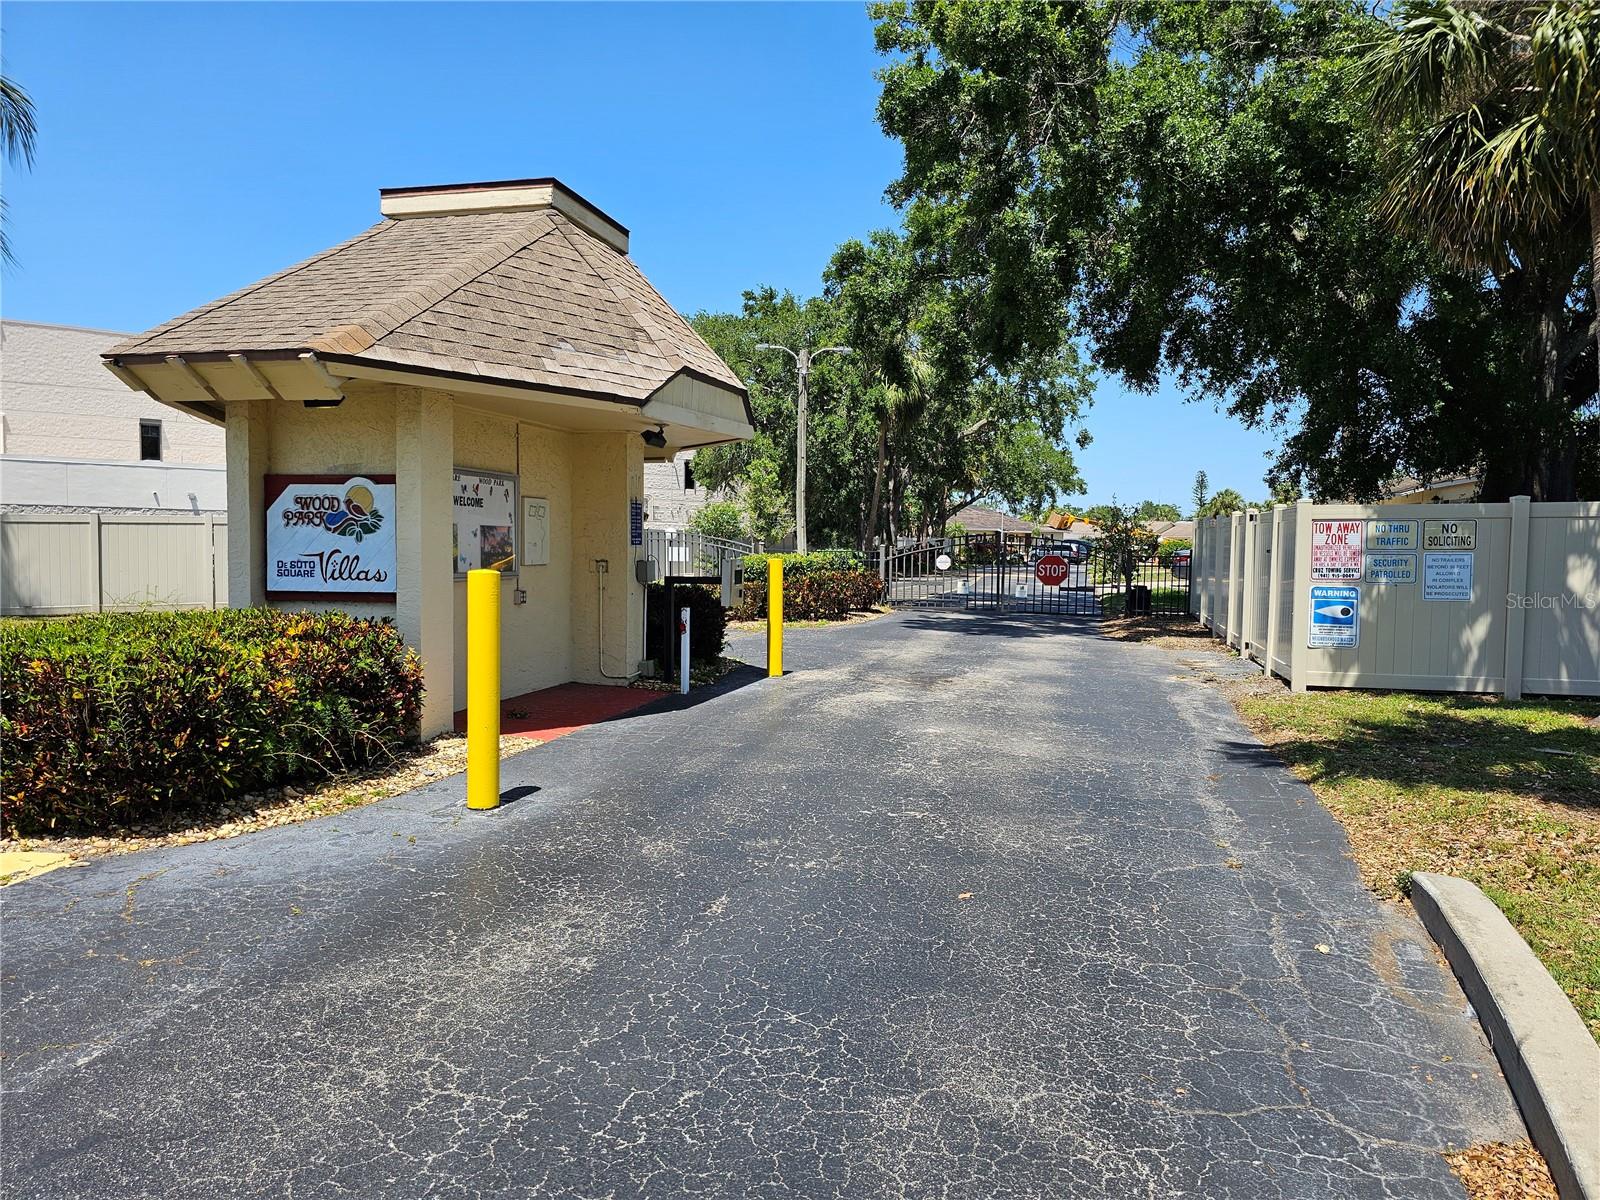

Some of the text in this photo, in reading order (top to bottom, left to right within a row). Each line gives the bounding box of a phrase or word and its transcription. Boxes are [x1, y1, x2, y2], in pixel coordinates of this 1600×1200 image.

[493, 479, 505, 487] PARK
[293, 494, 340, 512] WOOD
[453, 495, 484, 508] WELCOME
[283, 510, 328, 528] PARK
[1314, 523, 1360, 534] TOW AWAY
[1376, 525, 1410, 533] NO THRU
[1441, 524, 1458, 534] NO
[1325, 534, 1349, 545] ZONE
[1376, 537, 1409, 546] TRAFFIC
[1428, 536, 1472, 547] SOLICITING
[289, 560, 316, 569] SOTO
[298, 549, 388, 584] Villas
[1373, 559, 1409, 567] SECURITY
[276, 569, 316, 578] SQUARE
[1038, 564, 1067, 577] STOP
[1370, 570, 1411, 579] PATROLLED
